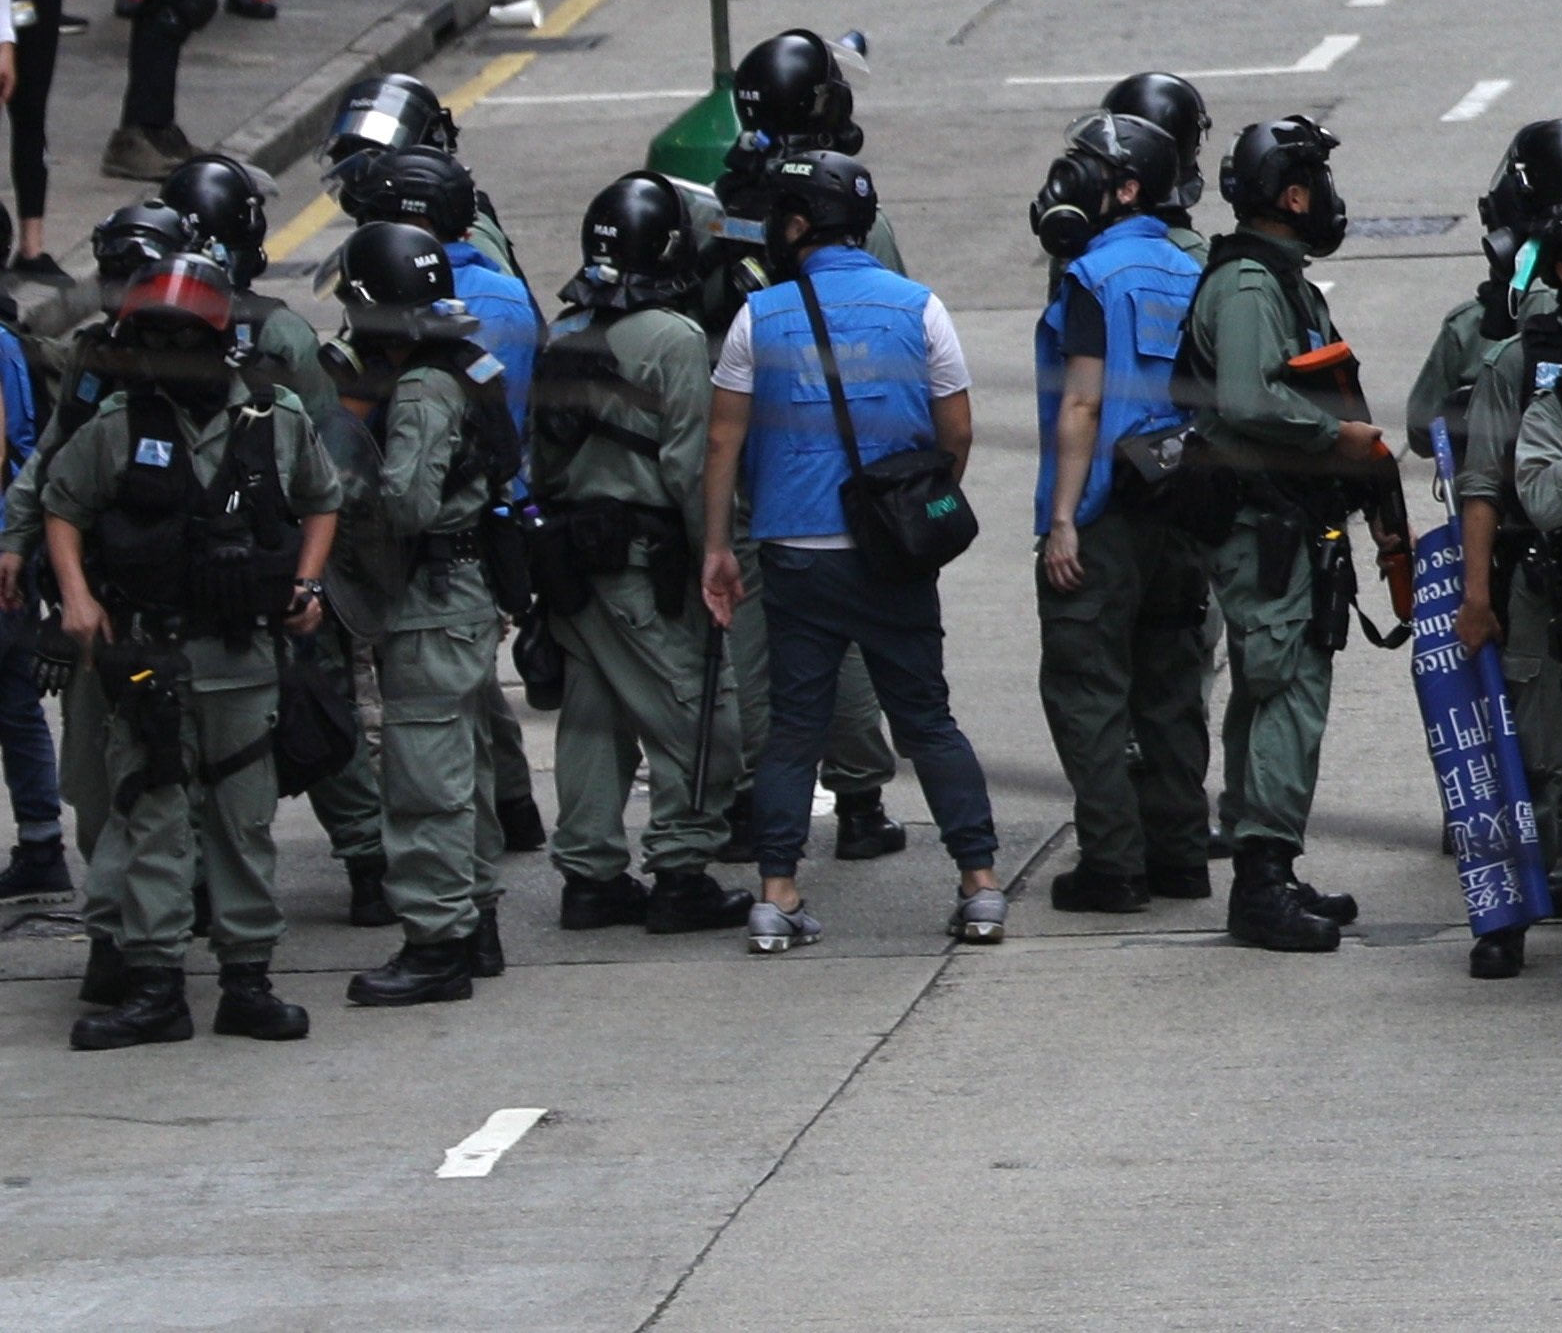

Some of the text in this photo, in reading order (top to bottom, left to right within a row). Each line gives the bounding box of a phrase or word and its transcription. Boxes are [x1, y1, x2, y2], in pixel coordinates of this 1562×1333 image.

[781, 163, 813, 176] POLICE
[593, 224, 618, 238] MAR
[414, 253, 439, 268] MAR
[427, 271, 436, 284] 3
[1413, 641, 1468, 676] olice
